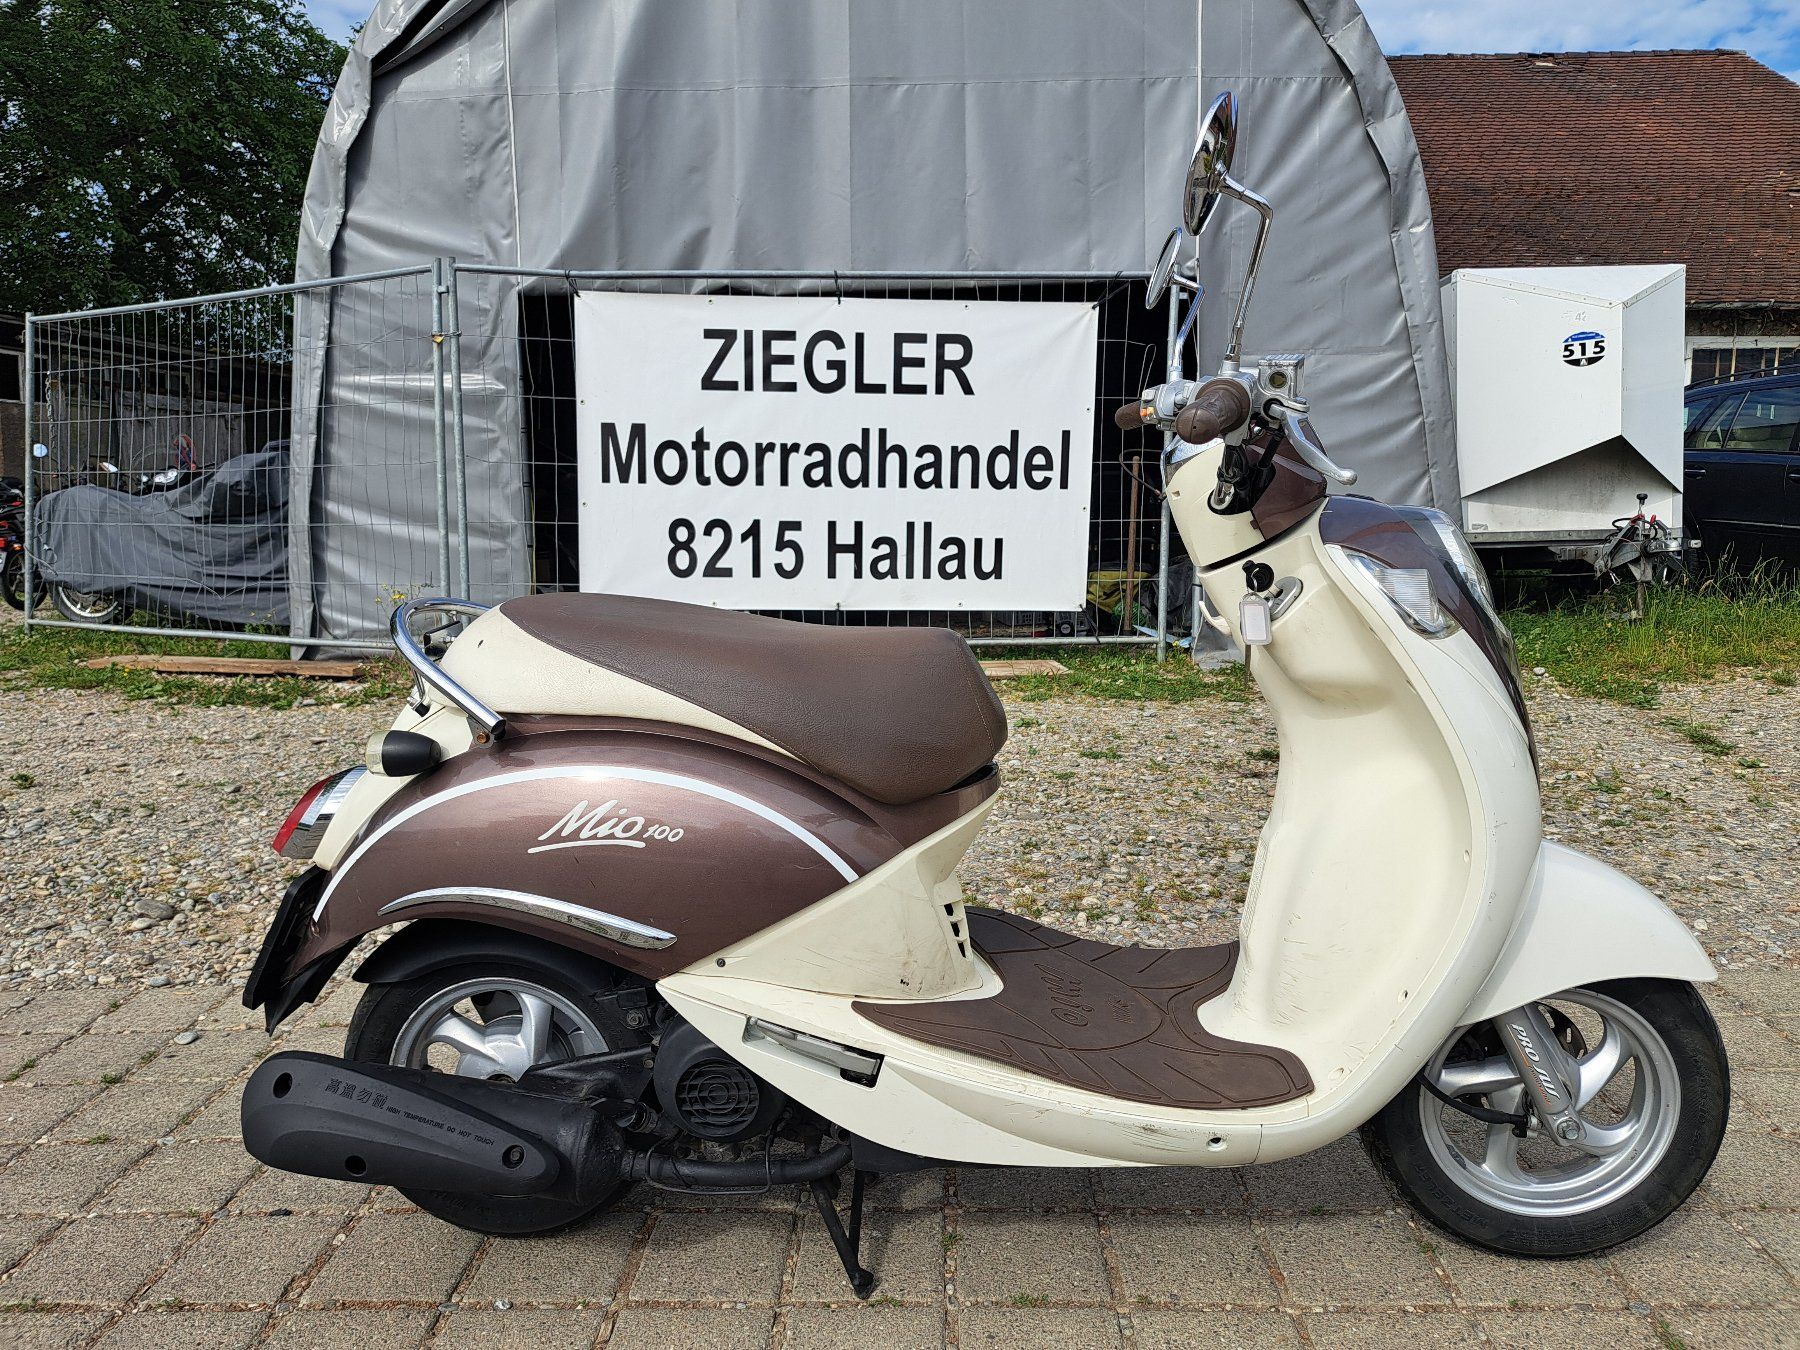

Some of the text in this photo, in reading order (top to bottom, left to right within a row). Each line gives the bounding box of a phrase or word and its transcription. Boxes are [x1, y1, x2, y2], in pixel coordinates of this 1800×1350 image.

[701, 329, 974, 395] ZIEGLER
[1562, 340, 1606, 358] 515
[601, 423, 1070, 490] Motorradhandel
[668, 518, 1003, 580] 8215 Hallau
[537, 800, 684, 842] Mio 100
[1510, 1023, 1540, 1062] PRO
[385, 1105, 495, 1146] HIGH TEMPERATURE DO NOT TOUCH
